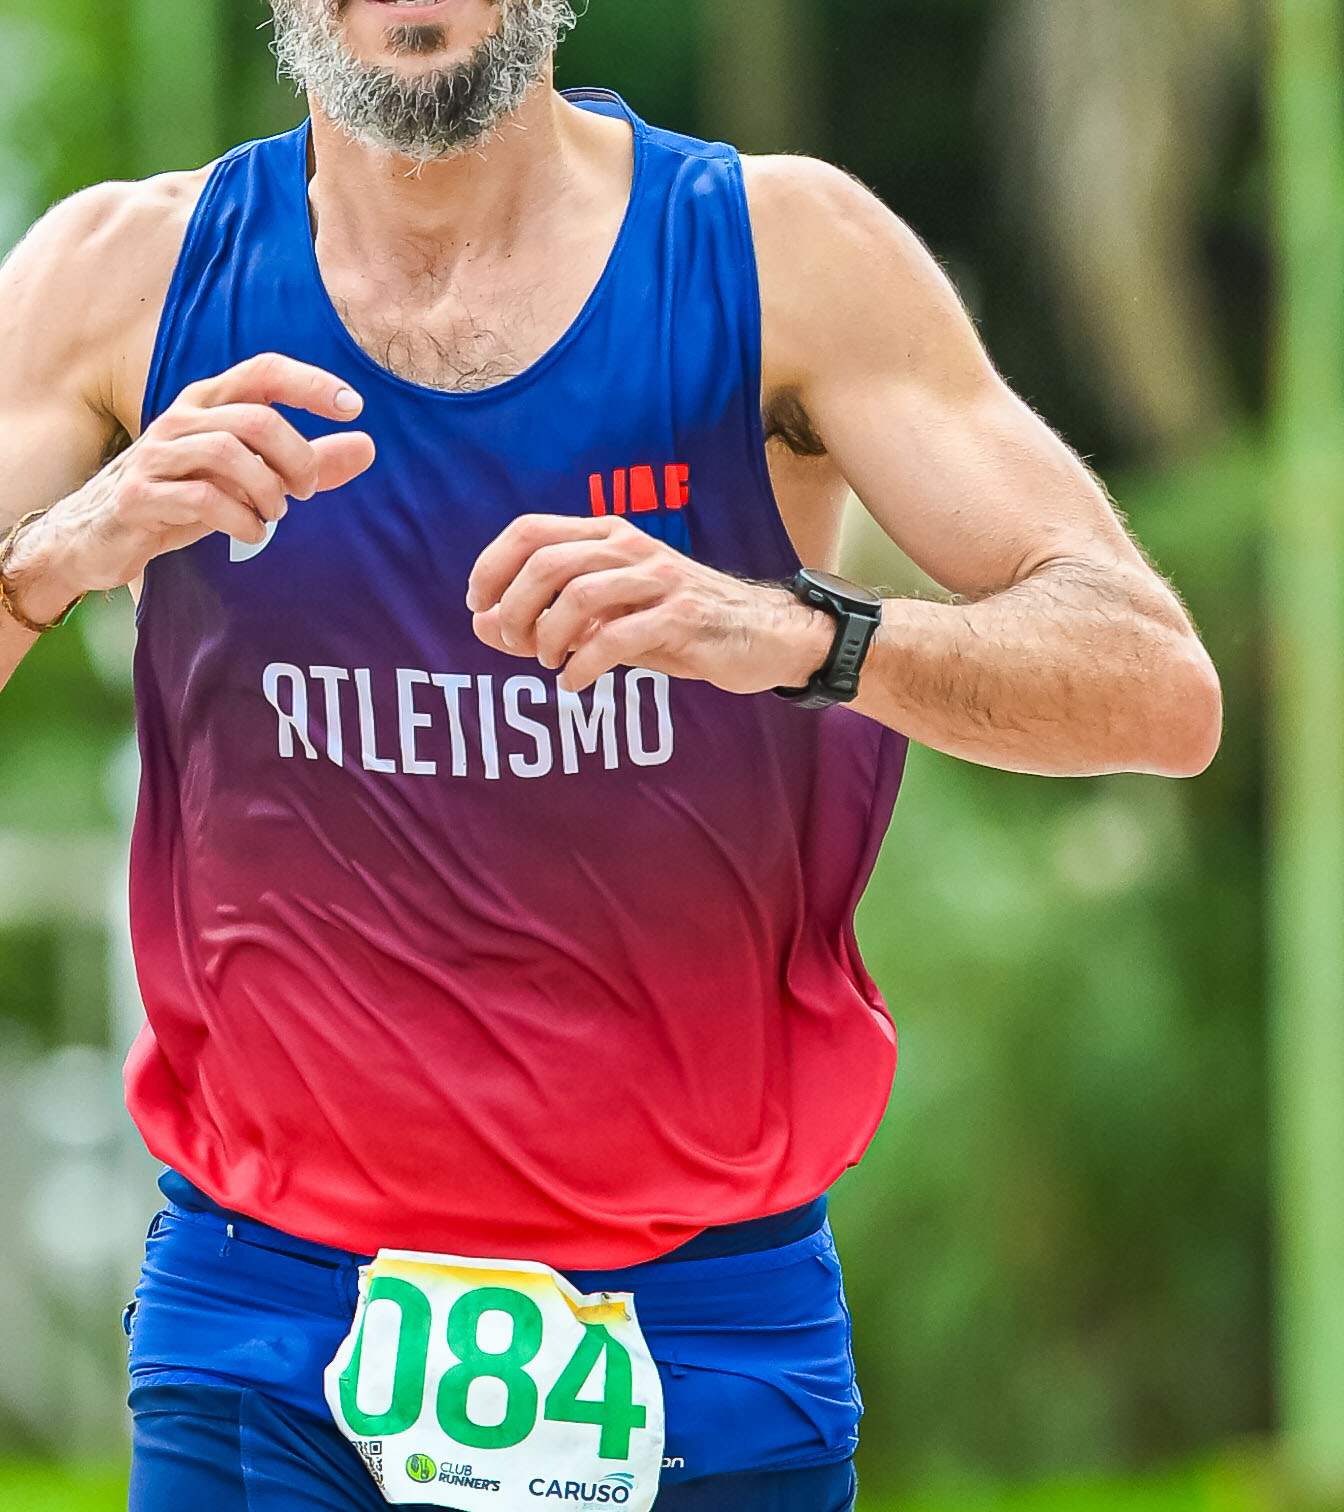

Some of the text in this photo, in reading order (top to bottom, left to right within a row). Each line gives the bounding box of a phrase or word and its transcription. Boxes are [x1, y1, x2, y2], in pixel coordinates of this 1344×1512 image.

[262, 662, 674, 779] ATLETISMO
[340, 1276, 646, 1460] 084
[438, 1472, 501, 1492] RUNNER'S
[440, 1461, 473, 1477] CLUB
[528, 1478, 630, 1504] CARUSO
